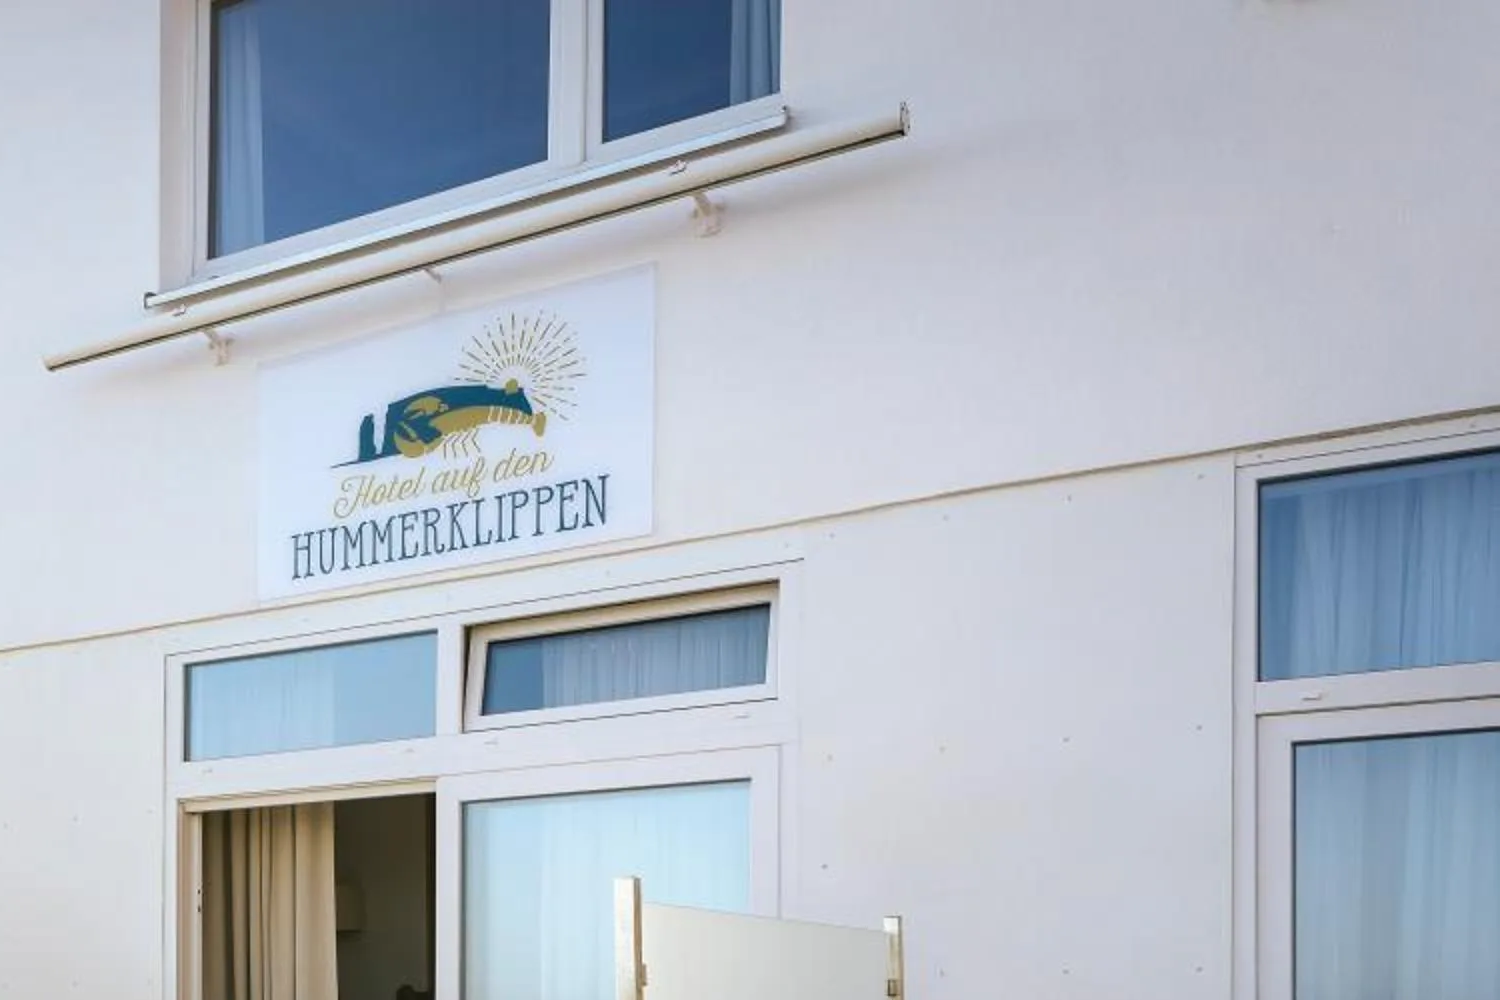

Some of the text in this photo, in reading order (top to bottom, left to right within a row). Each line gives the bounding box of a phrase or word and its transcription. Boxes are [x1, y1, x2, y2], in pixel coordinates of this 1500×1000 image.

[291, 474, 610, 579] HUMMERKLIPPEN
[333, 448, 555, 518] Hotel auf den
